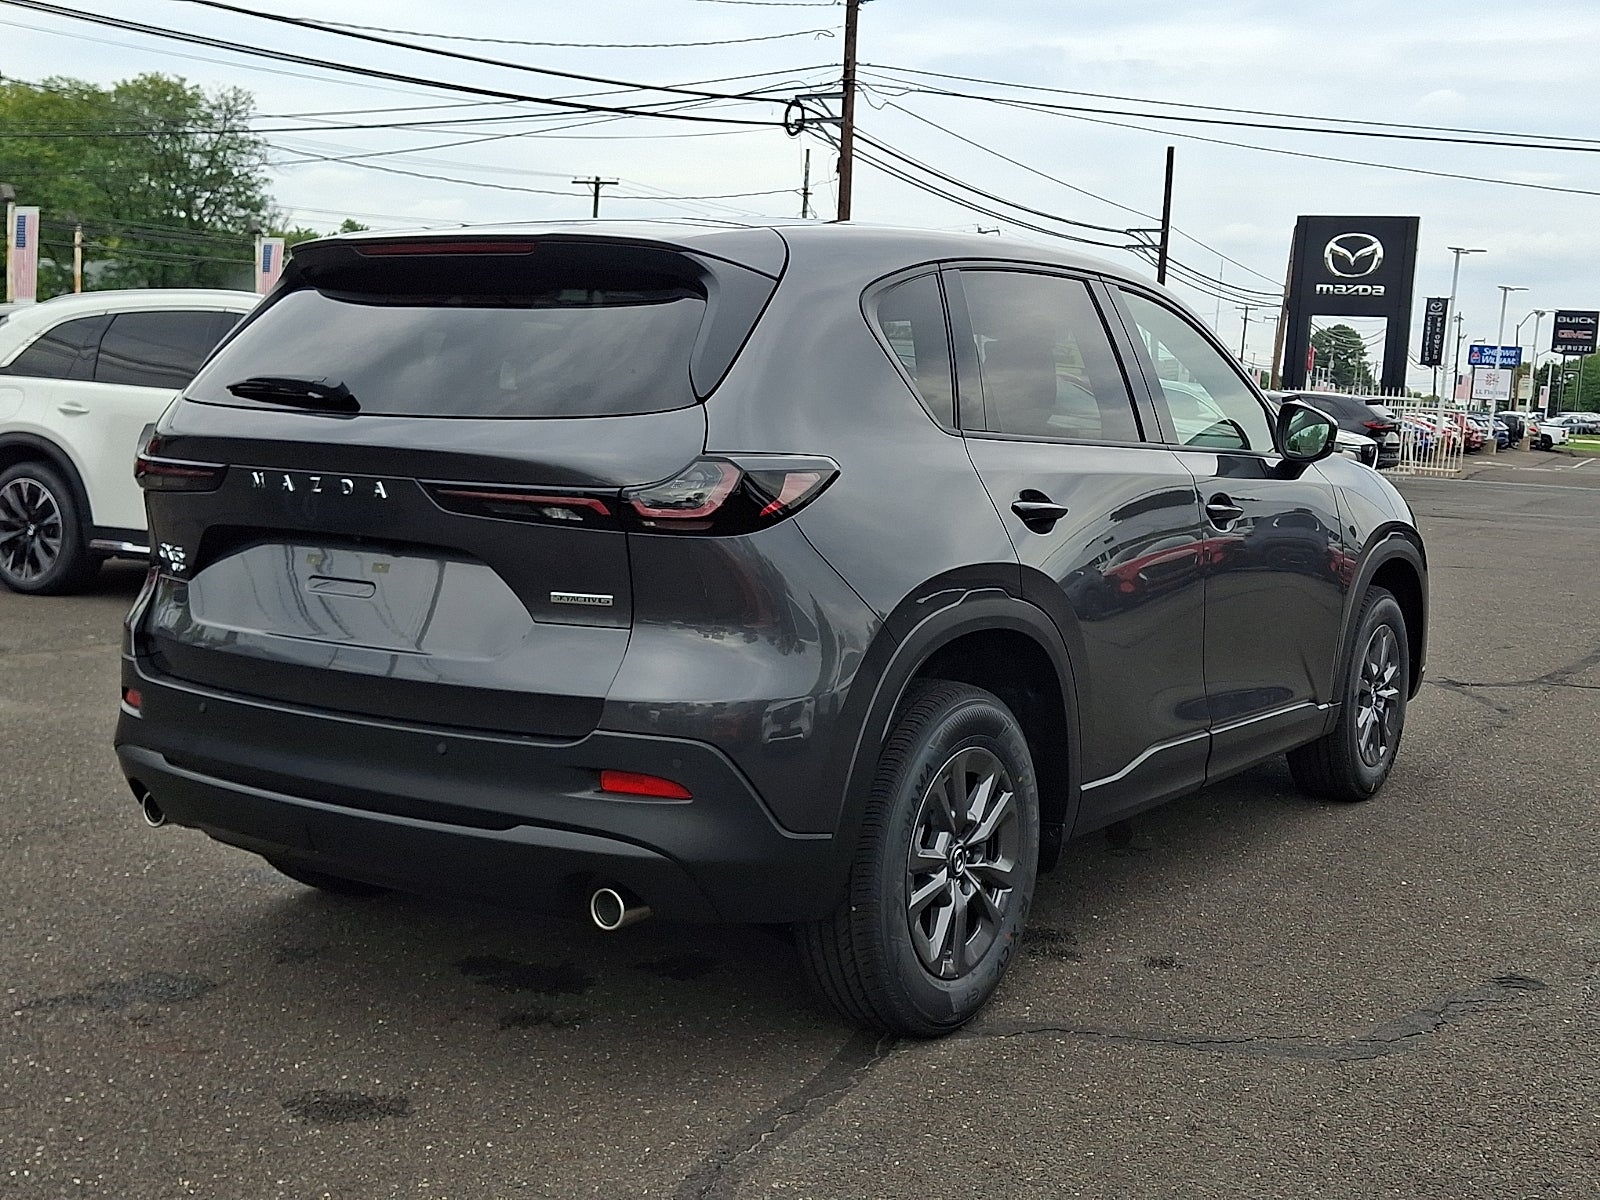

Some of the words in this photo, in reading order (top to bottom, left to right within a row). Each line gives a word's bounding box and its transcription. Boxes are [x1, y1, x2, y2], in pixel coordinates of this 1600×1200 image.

[1315, 284, 1385, 296] mazda
[1557, 316, 1596, 324] BUICK
[1558, 329, 1593, 340] GMC
[251, 471, 389, 499] MAZDA
